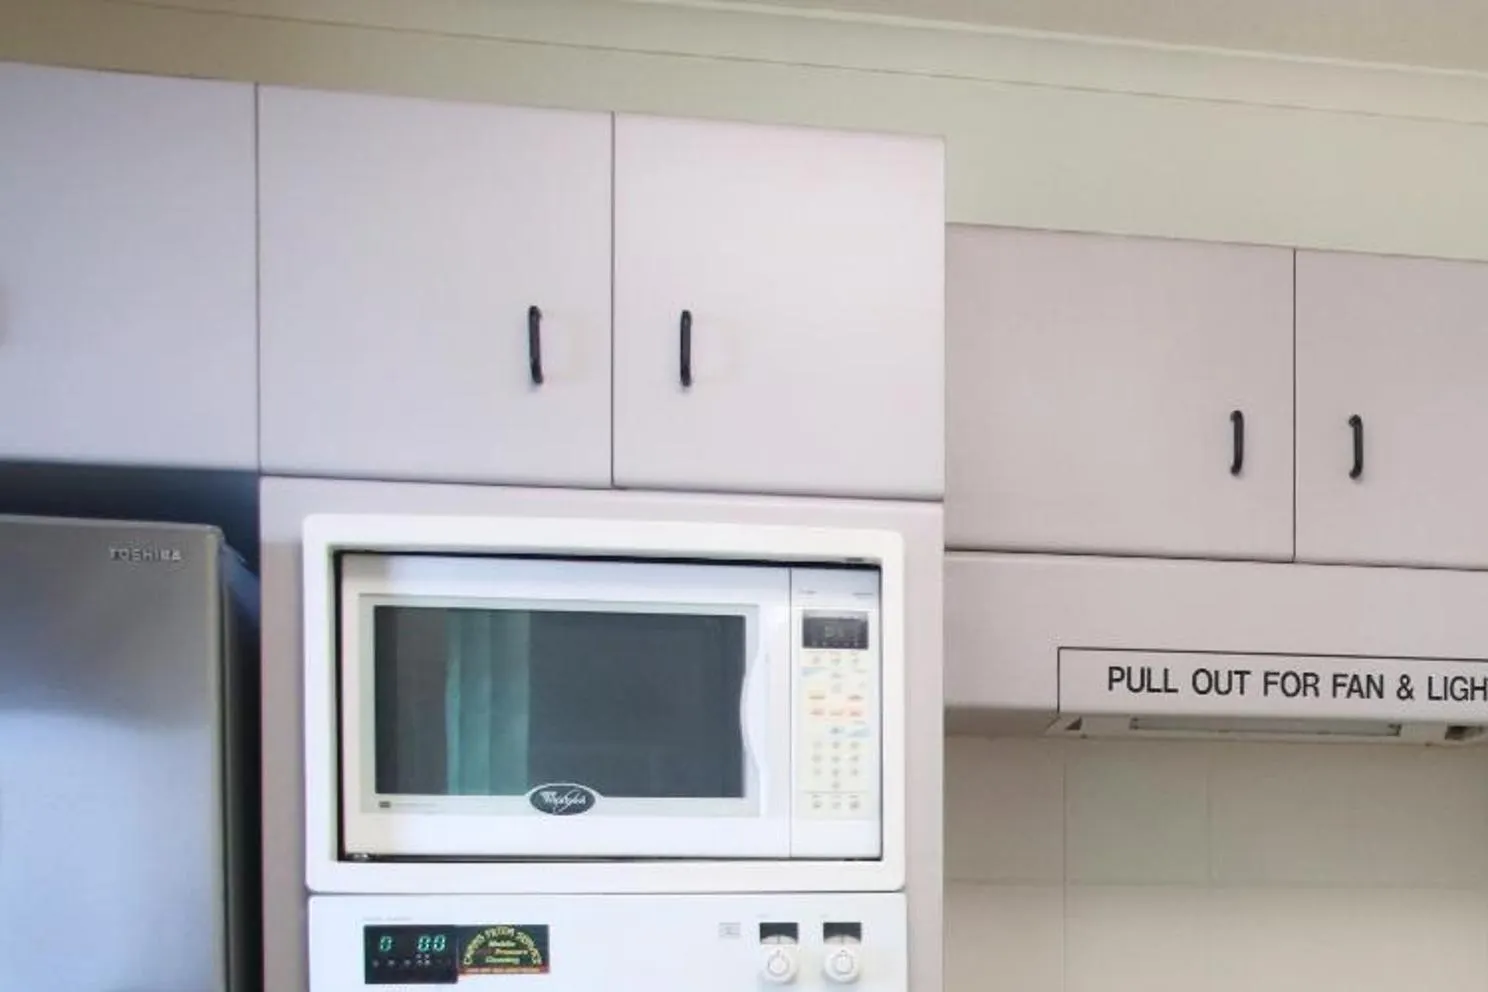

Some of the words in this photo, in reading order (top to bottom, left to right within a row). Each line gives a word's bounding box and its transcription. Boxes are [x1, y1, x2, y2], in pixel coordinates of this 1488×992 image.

[1107, 666, 1179, 694] PULL
[1191, 668, 1251, 696] OUT
[1263, 671, 1321, 698] FOR
[1332, 674, 1385, 700] FAN
[1396, 675, 1415, 701] &
